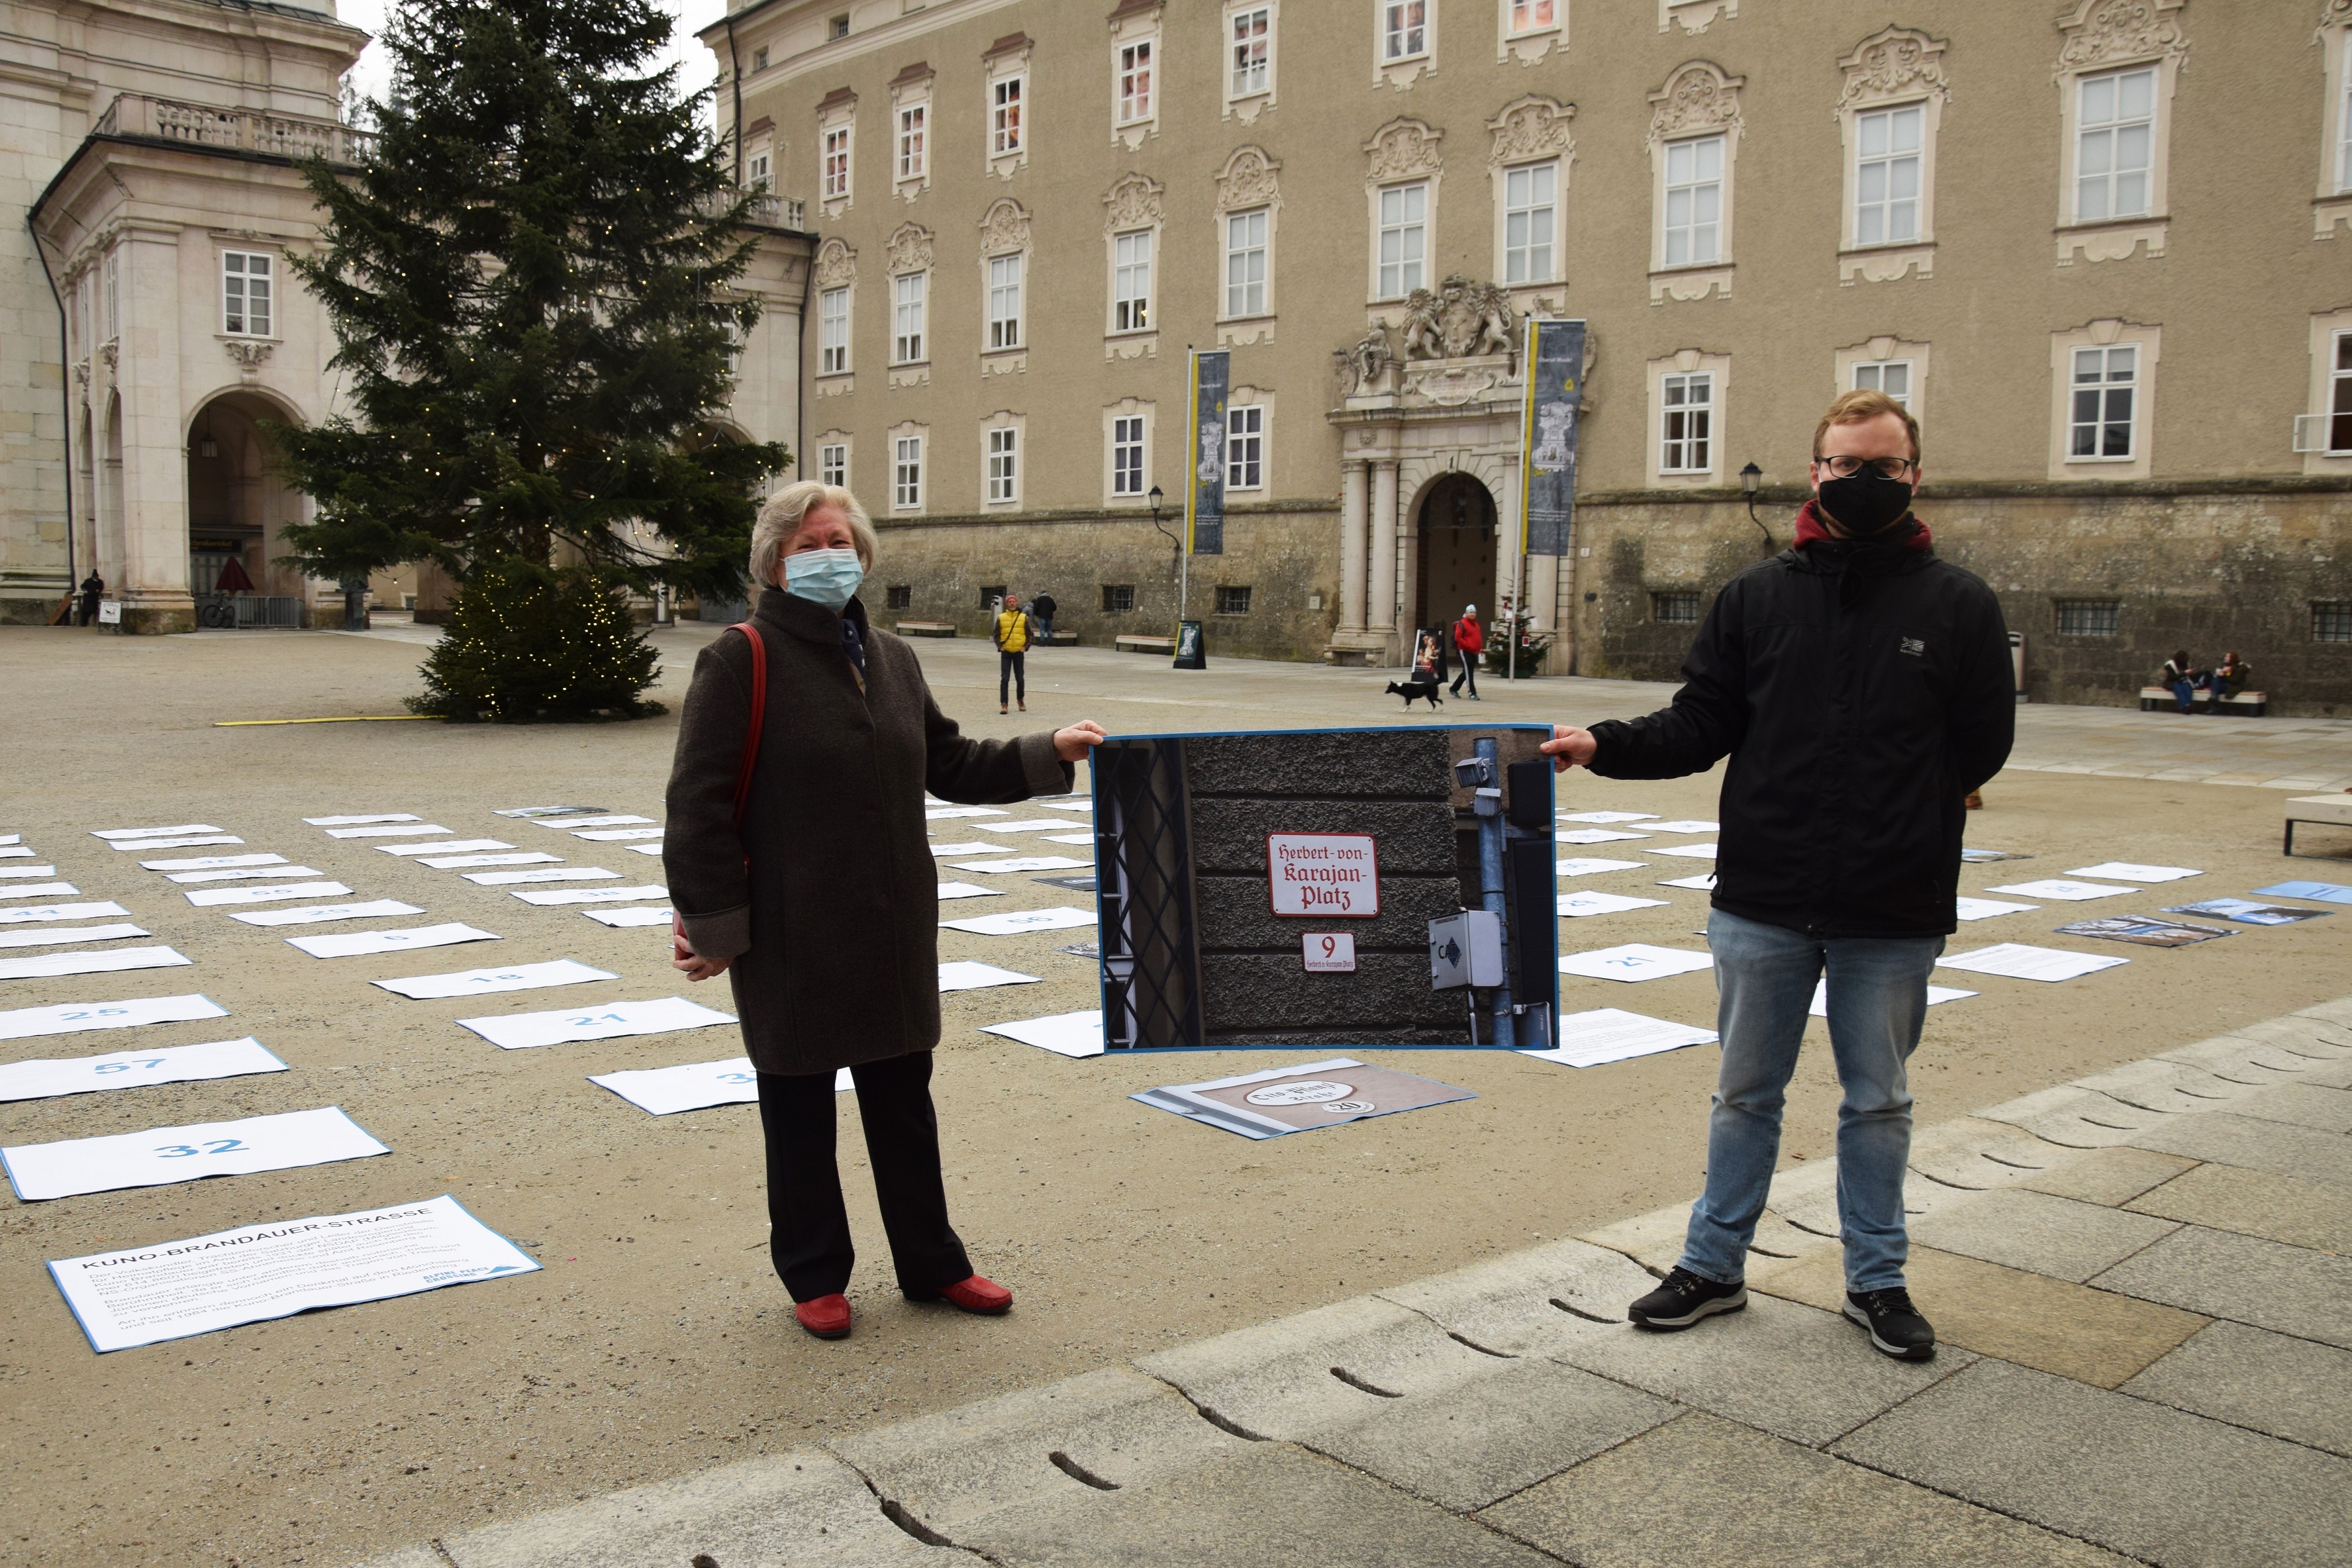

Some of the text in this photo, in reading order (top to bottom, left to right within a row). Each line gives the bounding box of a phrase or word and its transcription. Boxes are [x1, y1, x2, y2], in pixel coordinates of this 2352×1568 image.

[1284, 863, 1367, 885] Karajan-
[1301, 885, 1350, 911] Platz
[1007, 916, 1053, 924] 56
[1322, 936, 1335, 958] 9
[1438, 943, 1456, 959] CAT
[1605, 956, 1656, 968] 21
[468, 973, 525, 983] 18
[59, 1007, 129, 1022] 25
[565, 1013, 629, 1027] 21
[94, 1058, 166, 1075] 57
[716, 1070, 757, 1085] 3
[1329, 1102, 1361, 1110] 20
[154, 1138, 250, 1159] 32
[82, 1207, 434, 1269] KUNO-BRANDAUER-STRASSE
[356, 1235, 417, 1250] Rosenberg
[260, 1241, 321, 1254] Salzburger
[93, 1279, 127, 1287] Kuno
[131, 1267, 194, 1281] Brandauer
[222, 1255, 262, 1265] bereits
[316, 1238, 360, 1248] NSDAP
[182, 1262, 250, 1277] beigetreten
[277, 1250, 315, 1260] dockte
[104, 1289, 171, 1304] Brandauer
[173, 1280, 224, 1291] erlangte
[226, 1273, 258, 1282] unter
[260, 1262, 312, 1275] anderem
[314, 1254, 360, 1265] deshalb
[108, 1298, 169, 1313] Jüdinnen
[171, 1288, 229, 1300] deutsche
[230, 1273, 292, 1290] Vornamen
[343, 1257, 385, 1267] Tragen
[410, 1247, 457, 1255] Trachten
[421, 1270, 456, 1280] ALPINE
[424, 1272, 478, 1283] CROSSING
[162, 1303, 216, 1317] erinnern
[218, 1292, 272, 1306] dennoch
[295, 1276, 350, 1288] Denkmal
[399, 1258, 470, 1270] Mönchsberg
[120, 1321, 146, 1330] und
[148, 1316, 172, 1324] seit
[176, 1309, 208, 1319] 1984
